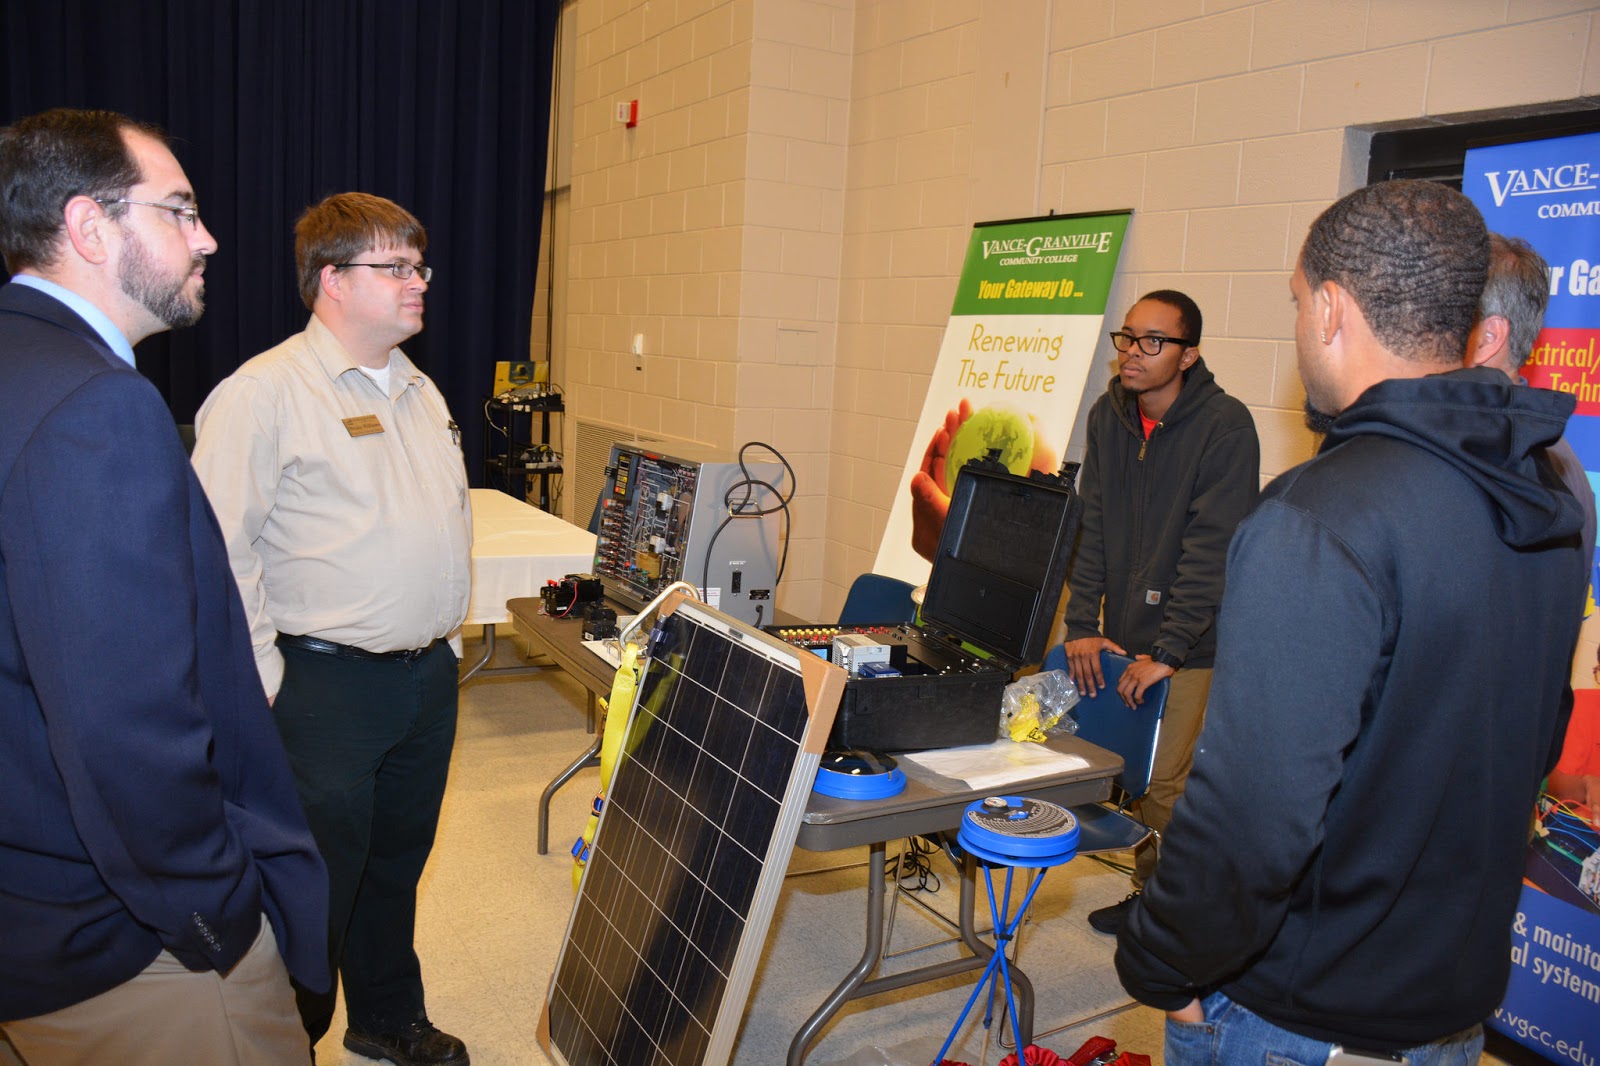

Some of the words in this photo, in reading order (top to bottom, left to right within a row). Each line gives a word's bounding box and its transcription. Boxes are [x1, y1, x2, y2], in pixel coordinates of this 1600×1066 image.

[1484, 163, 1599, 207] VANCE-
[982, 232, 1112, 260] VANCE-GRANVILLE
[999, 256, 1044, 266] COMMUNITY
[1044, 254, 1078, 264] COLLEGE
[978, 280, 1005, 299] Your
[1005, 279, 1059, 300] Gateway
[1548, 266, 1564, 296] r
[968, 323, 1064, 361] Renewing
[957, 359, 989, 389] The
[993, 360, 1055, 393] Future
[1513, 912, 1527, 937] &
[1511, 941, 1529, 968] al
[1533, 957, 1600, 1004] system
